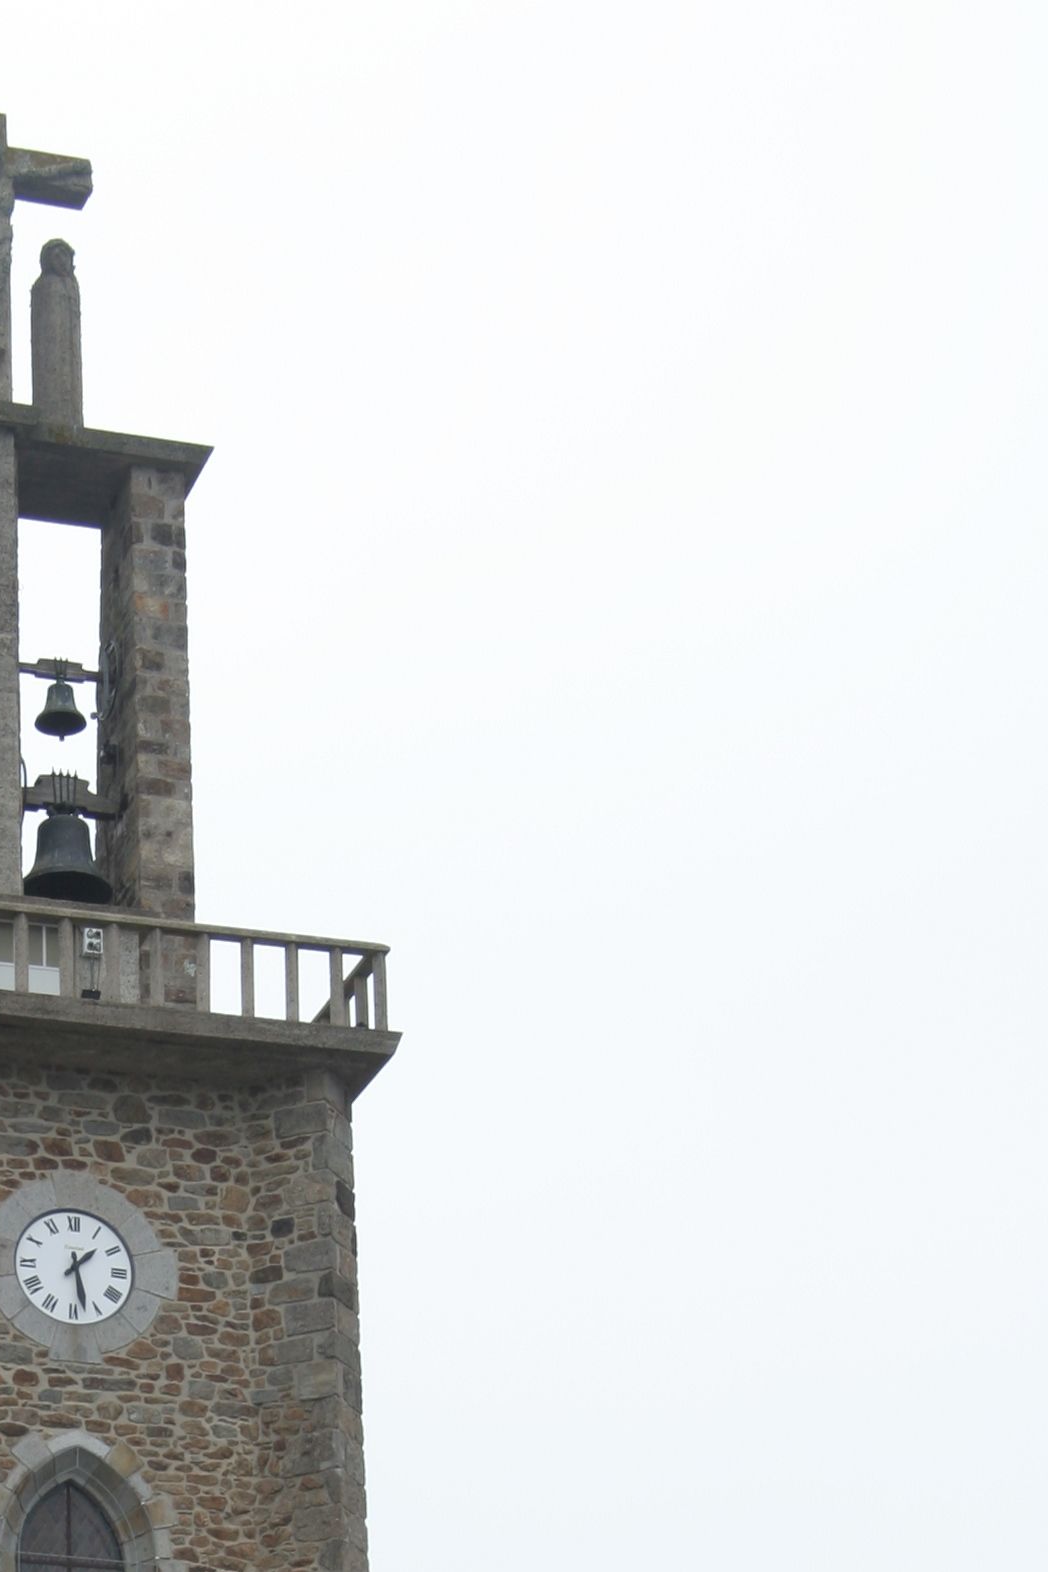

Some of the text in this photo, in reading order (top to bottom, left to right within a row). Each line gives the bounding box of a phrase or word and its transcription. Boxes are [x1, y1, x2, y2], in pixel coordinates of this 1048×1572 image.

[44, 1218, 59, 1235] XI
[67, 1216, 80, 1232] XII
[92, 1226, 101, 1239] I
[26, 1235, 43, 1247] X
[105, 1246, 121, 1256] II
[20, 1257, 36, 1268] IX
[111, 1268, 127, 1279] III
[23, 1275, 44, 1295] VIII
[42, 1294, 59, 1313] VII
[92, 1301, 103, 1316] V
[69, 1303, 78, 1320] VI
